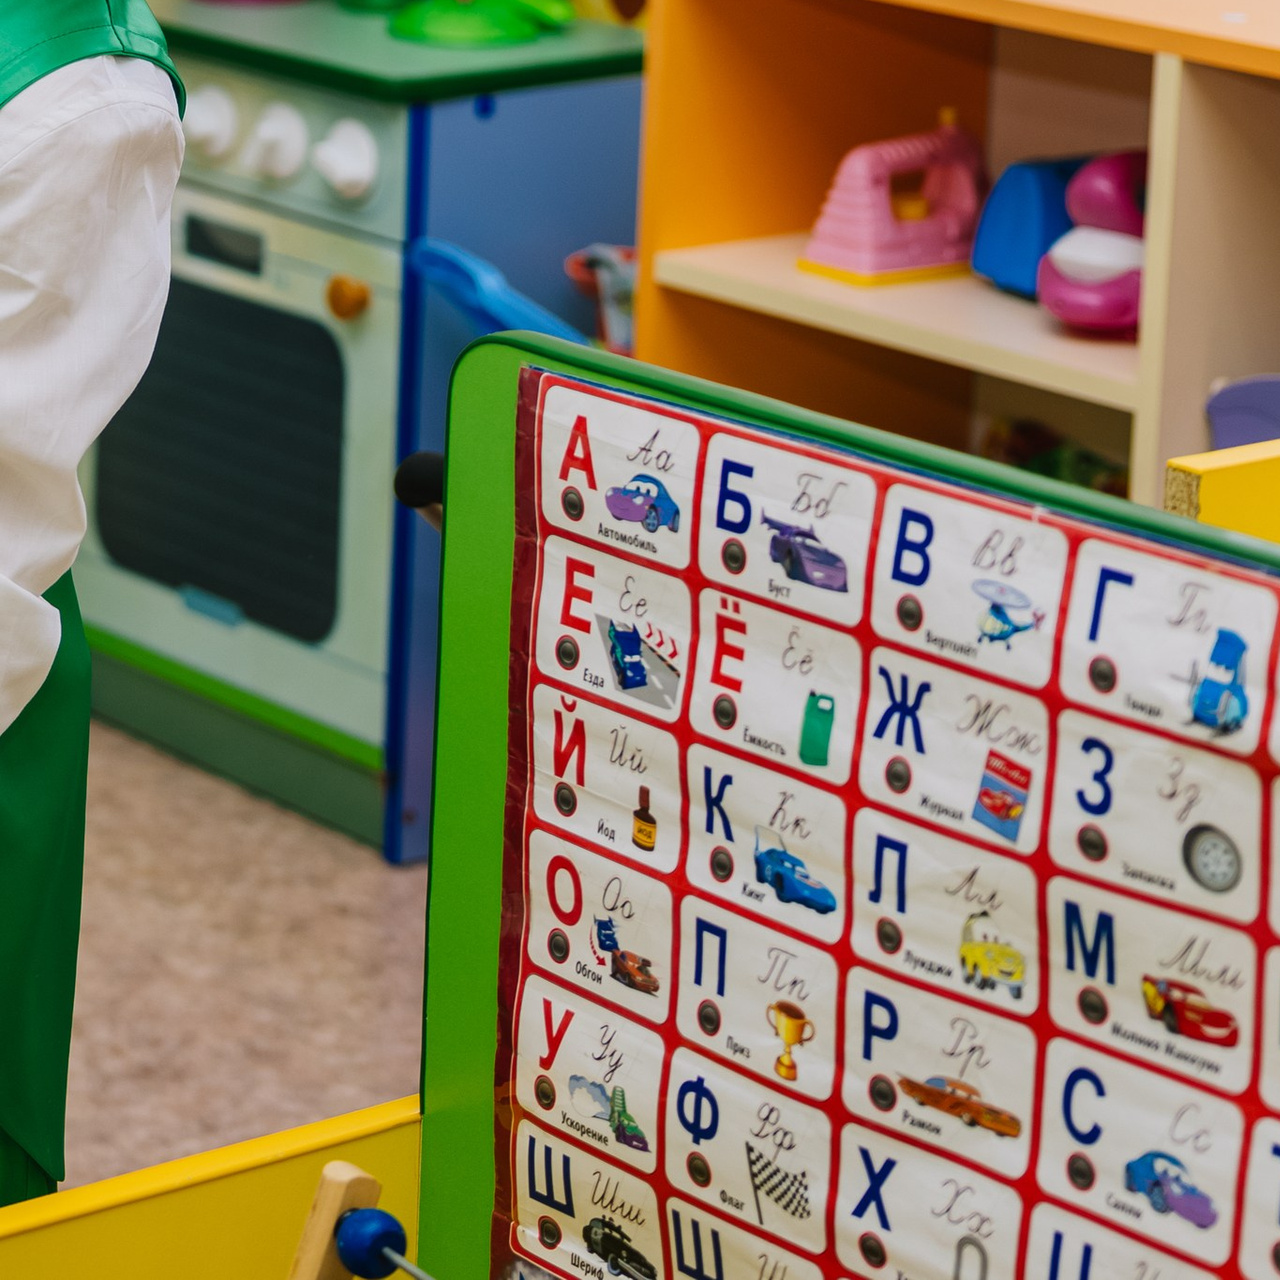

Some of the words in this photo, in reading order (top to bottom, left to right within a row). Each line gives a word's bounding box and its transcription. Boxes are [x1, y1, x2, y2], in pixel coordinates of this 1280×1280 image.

[559, 415, 597, 491] А
[627, 429, 675, 472] Аа
[716, 458, 754, 534] Б
[791, 473, 849, 519] Бб
[598, 523, 657, 553] Автомобиль
[891, 507, 934, 587] В
[972, 528, 1025, 576] Вв
[560, 556, 595, 634] Е
[619, 575, 648, 617] Ее
[768, 578, 791, 598] Буст
[1089, 566, 1134, 642] Г
[1167, 581, 1212, 633] Гг
[710, 597, 747, 693] Ё
[782, 624, 814, 675] Ёё
[583, 668, 605, 688] Езда
[873, 665, 931, 754] Ж
[956, 693, 1043, 755] Жж
[554, 695, 586, 788] Й
[610, 724, 648, 774] Йй
[743, 726, 786, 756] Ёмкость
[704, 765, 735, 843] К
[1076, 736, 1114, 816] З
[1157, 755, 1201, 824] Зз
[597, 818, 616, 842] Йод
[769, 791, 811, 840] Кк
[546, 855, 583, 926] О
[602, 876, 635, 919] Оо
[868, 833, 908, 914] Л
[945, 866, 1003, 911] Лл
[575, 960, 603, 985] Обгон
[694, 917, 727, 997] П
[1064, 899, 1116, 987] М
[1158, 934, 1246, 991] Мм
[757, 947, 810, 1001] Пп
[539, 997, 575, 1071] У
[591, 1024, 623, 1083] Уу
[726, 1035, 751, 1059] Приз
[862, 989, 899, 1061] Р
[941, 1016, 991, 1079] Рр
[561, 1110, 609, 1147] Ускорение
[676, 1075, 719, 1146] Ф
[749, 1102, 797, 1164] Фф
[1062, 1067, 1106, 1145] С
[1170, 1101, 1213, 1155] Сс
[528, 1134, 575, 1219] Ш
[590, 1170, 646, 1226] Шш
[720, 1189, 745, 1211] Флаг
[850, 1145, 898, 1232] Х
[931, 1178, 995, 1239] Хх
[570, 1252, 604, 1280] Шериф
